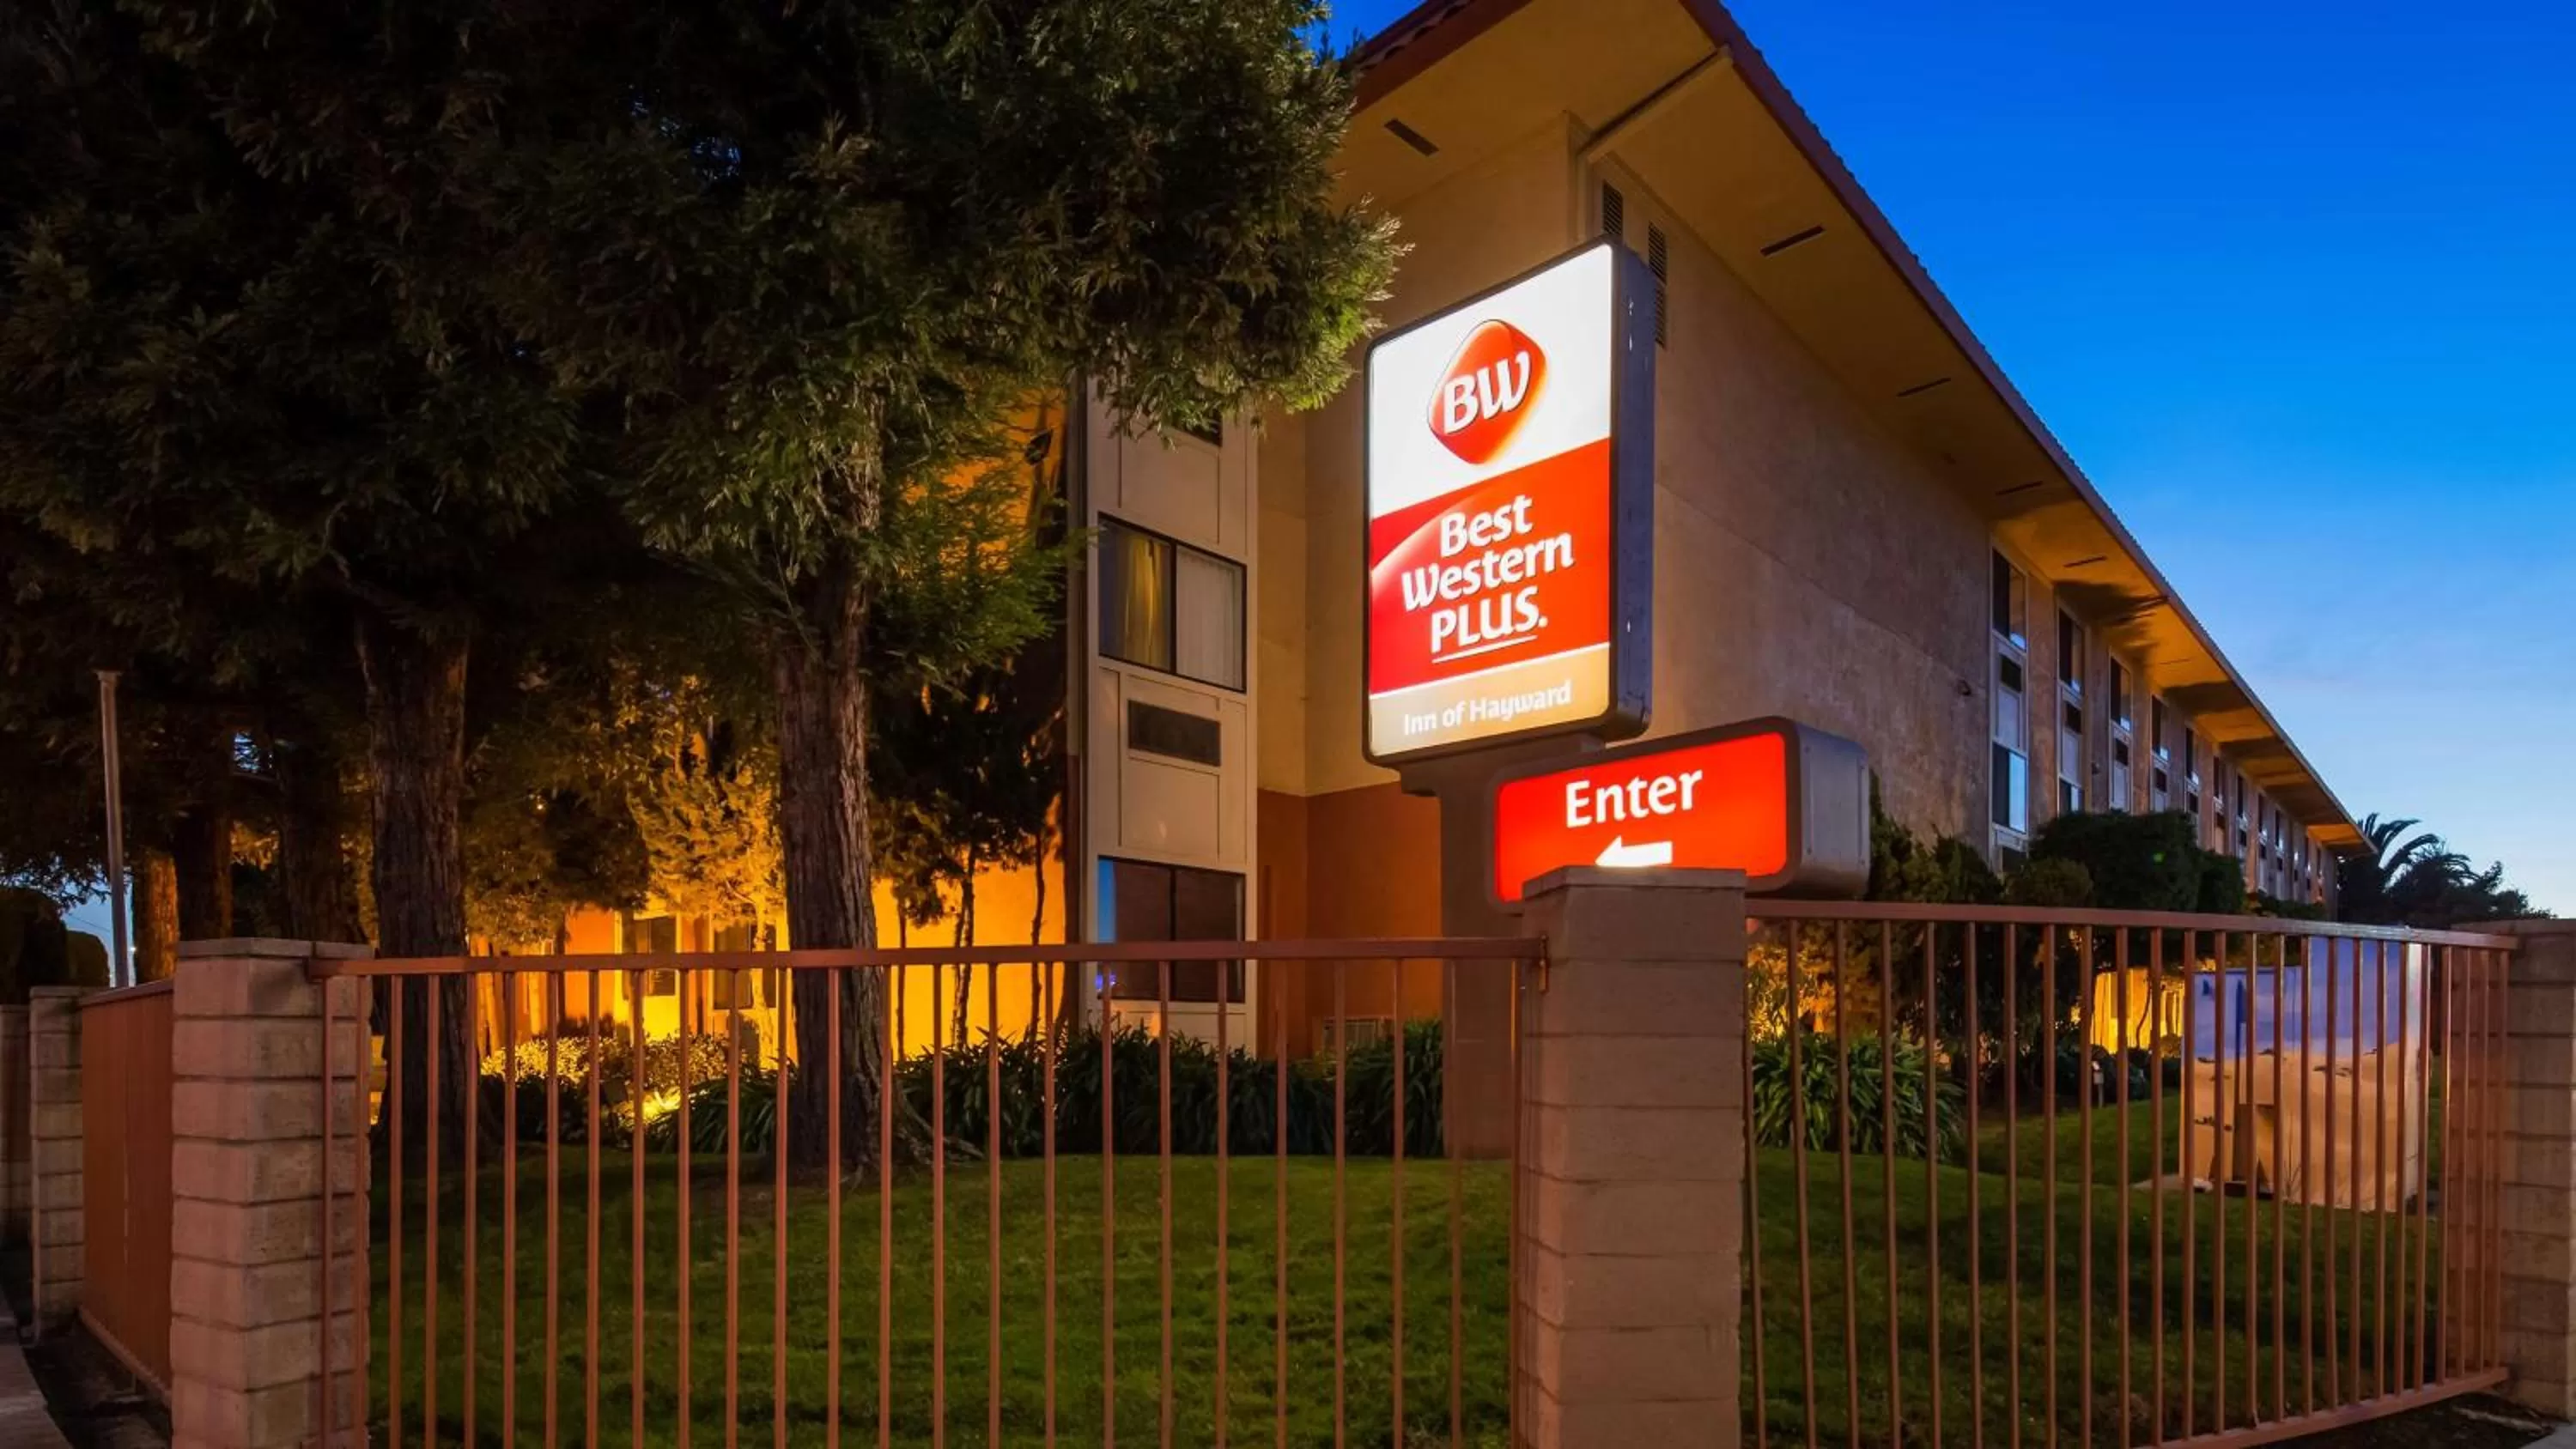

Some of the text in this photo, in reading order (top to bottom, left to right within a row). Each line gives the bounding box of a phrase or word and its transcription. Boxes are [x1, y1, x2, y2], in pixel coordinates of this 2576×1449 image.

[1443, 350, 1530, 434] BW
[1440, 494, 1533, 557] Best
[1401, 532, 1575, 611] Western
[1404, 678, 1571, 736] Inn of Hayward
[1566, 769, 1703, 828] Enter
